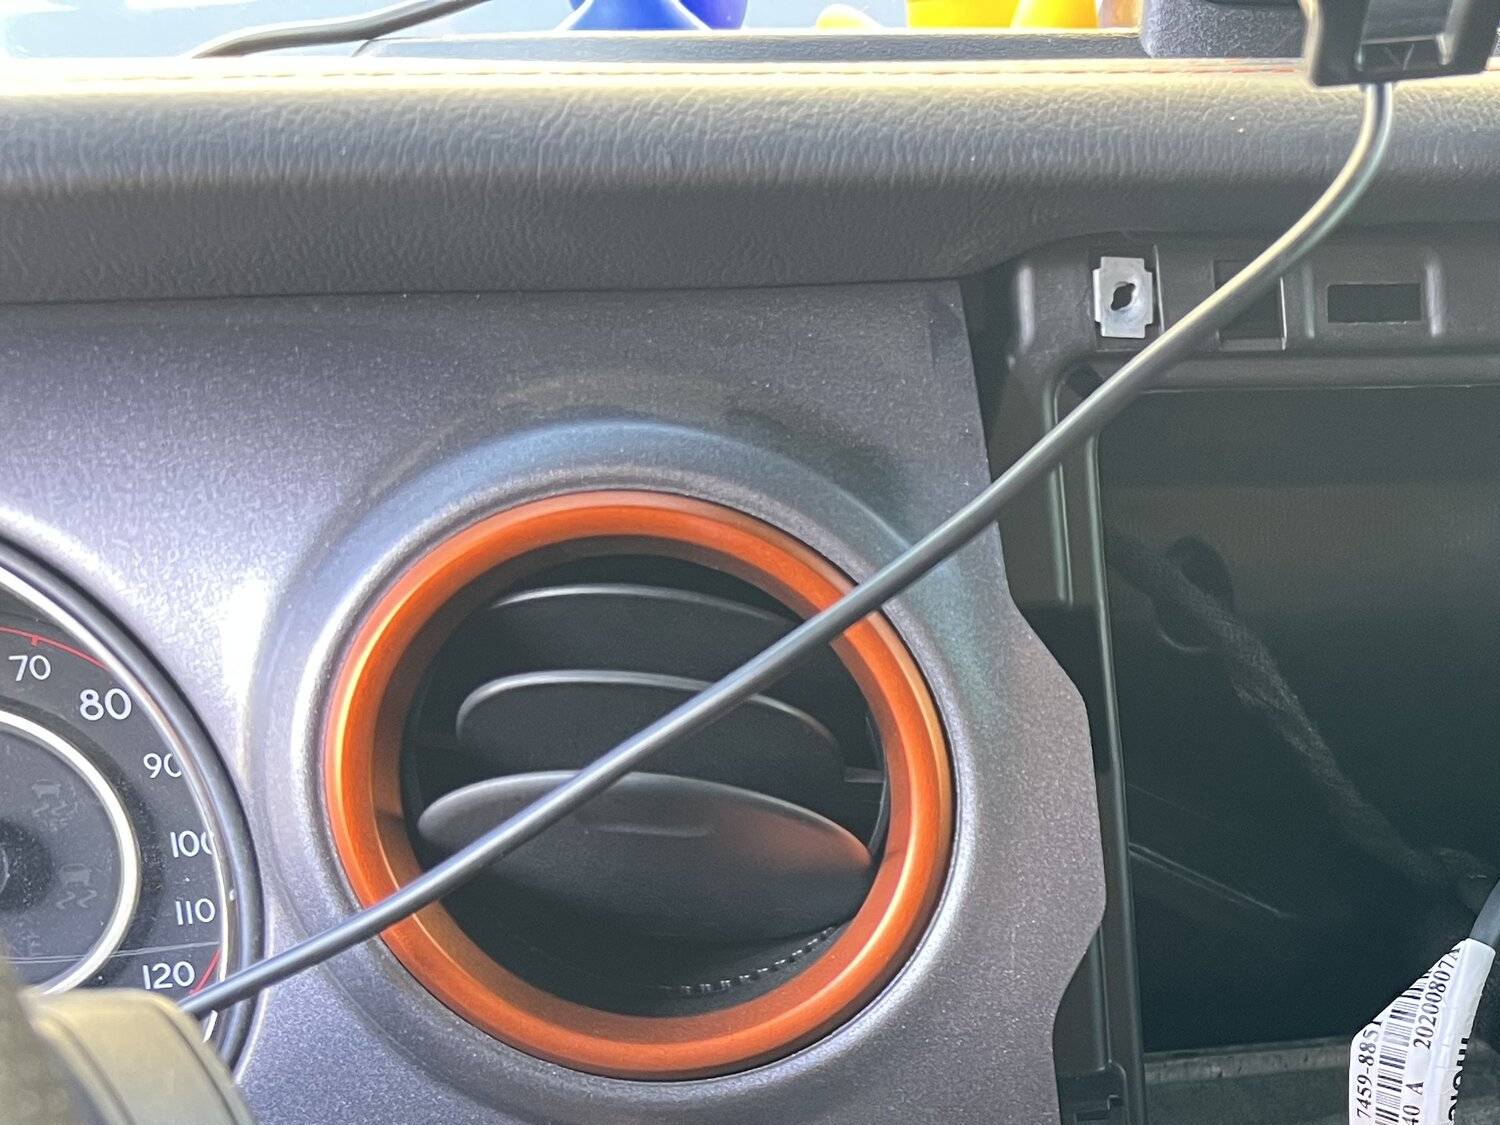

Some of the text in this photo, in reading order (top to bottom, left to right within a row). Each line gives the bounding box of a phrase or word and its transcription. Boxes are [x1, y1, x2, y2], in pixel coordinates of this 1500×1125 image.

[8, 655, 51, 681] 70
[80, 688, 131, 720] 80
[175, 898, 216, 926] 110
[142, 961, 195, 990] 120
[1405, 1081, 1425, 1096] A
